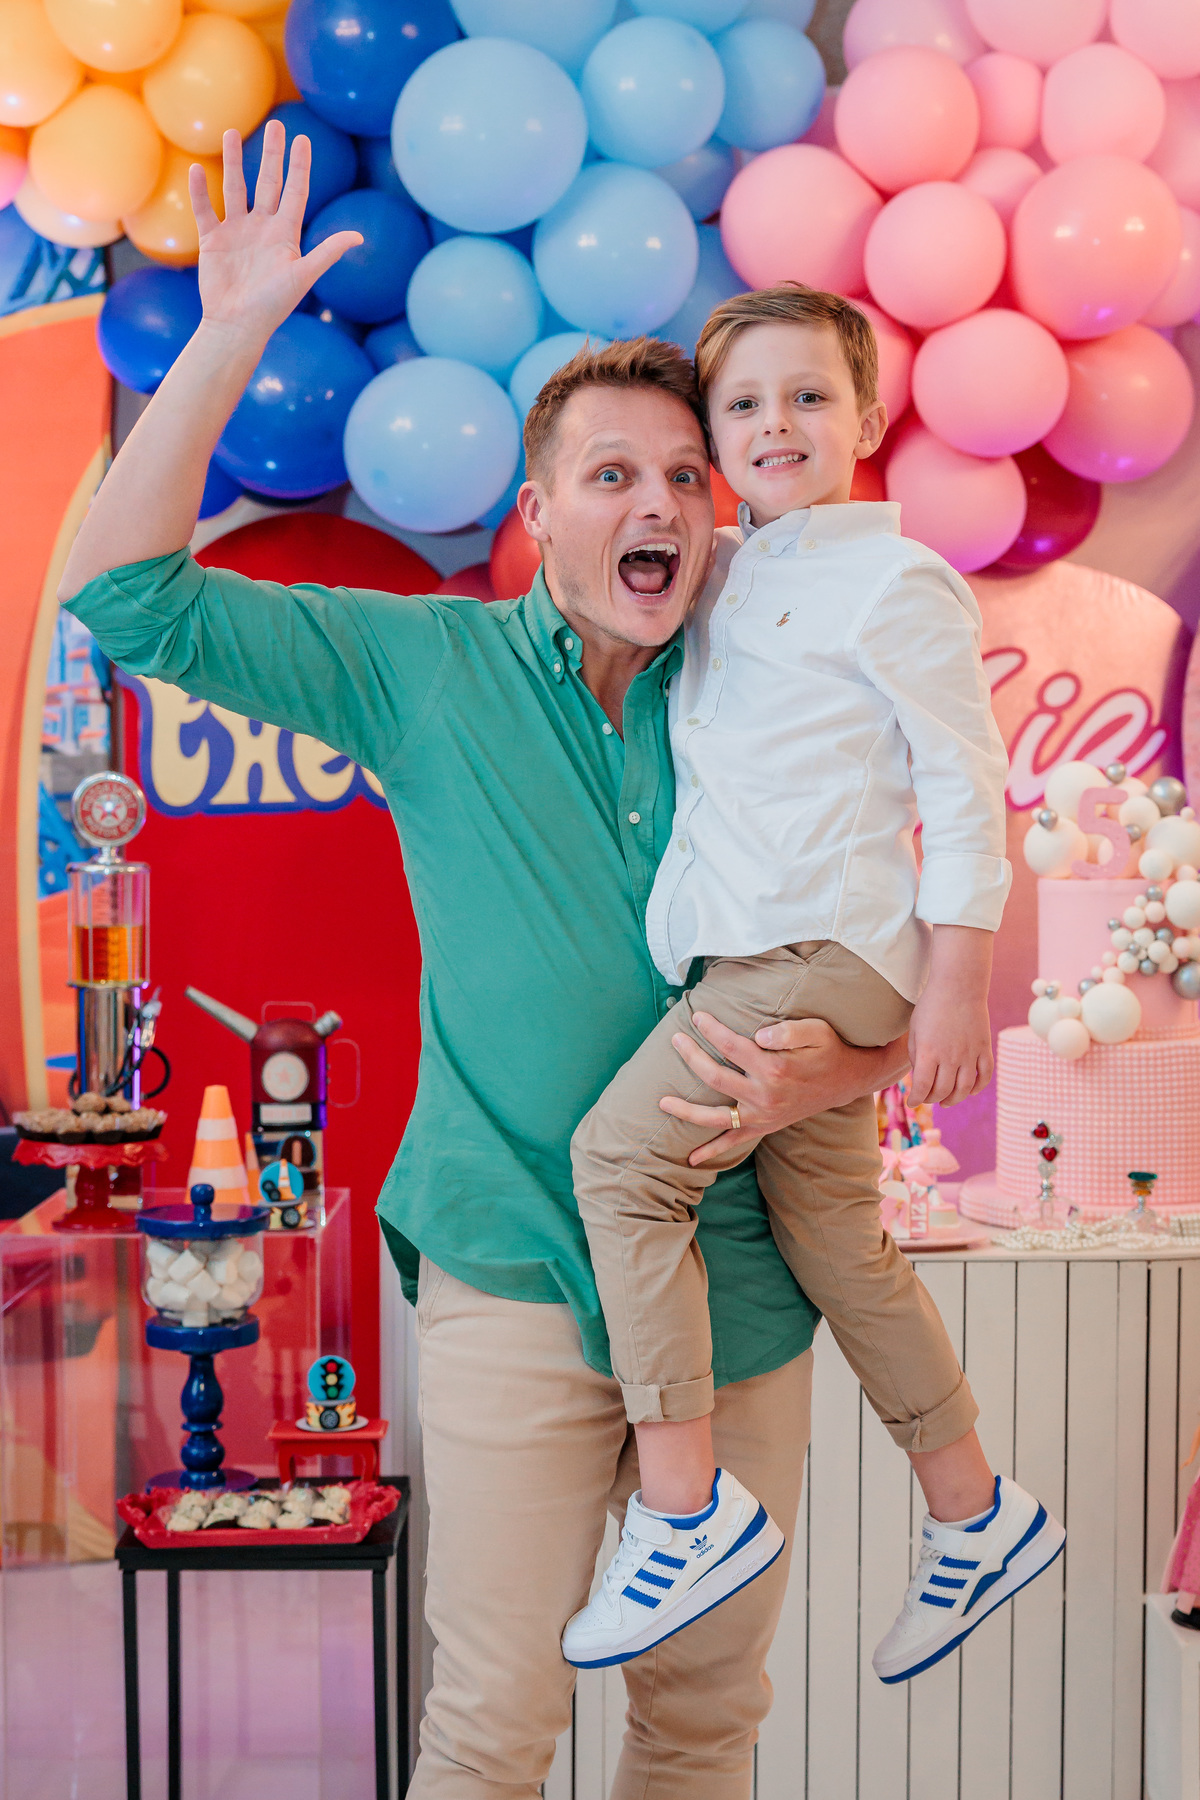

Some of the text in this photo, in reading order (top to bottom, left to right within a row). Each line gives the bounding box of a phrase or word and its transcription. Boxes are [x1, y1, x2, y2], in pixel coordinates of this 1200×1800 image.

[134, 674, 388, 807] tHe
[980, 647, 1172, 811] ie
[1071, 787, 1131, 879] 5
[696, 1544, 714, 1558] adidas
[732, 1560, 757, 1581] adidas
